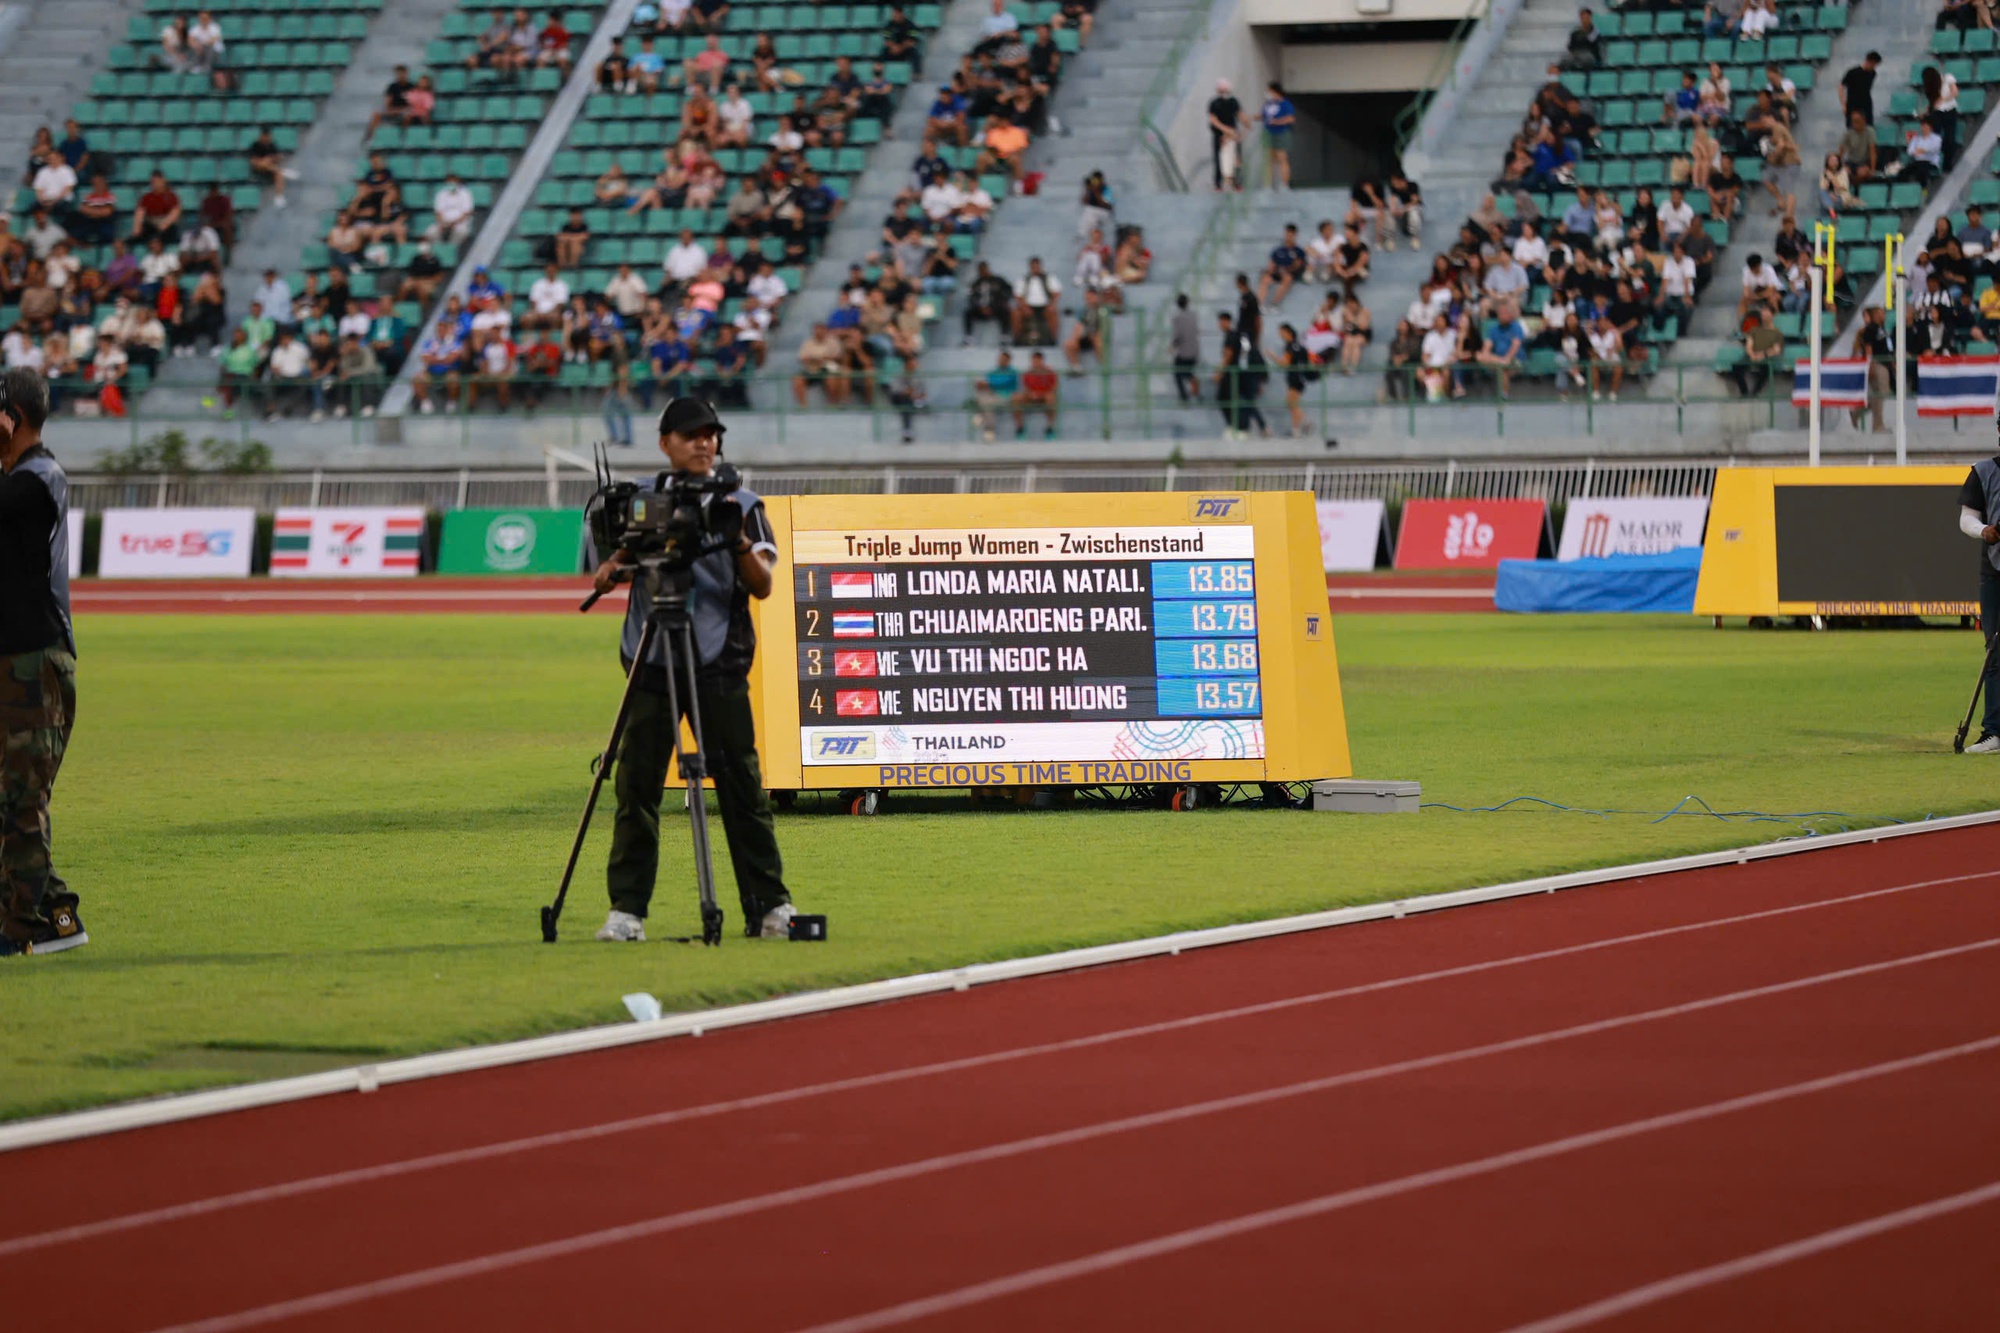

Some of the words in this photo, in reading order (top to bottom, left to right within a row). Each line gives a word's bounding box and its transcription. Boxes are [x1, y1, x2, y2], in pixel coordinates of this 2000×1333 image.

[1619, 520, 1682, 539] MAJOR
[844, 535, 901, 561] Triple
[908, 535, 962, 560] Jump
[968, 534, 1039, 555] Women
[1060, 532, 1204, 554] Zwischenstand
[807, 570, 814, 598] 1
[873, 572, 898, 598] INA
[907, 570, 981, 595] LONDA
[988, 569, 1057, 594] MARIA
[1063, 568, 1145, 593] NATALI.
[1188, 565, 1253, 592] 13.85
[806, 609, 820, 636] 2
[876, 612, 904, 637] THA
[910, 607, 1083, 634] CHUAIMAROENG
[1090, 607, 1147, 632] PARI.
[1192, 604, 1254, 631] 13.79
[1816, 601, 1881, 615] PRECIOUS
[1886, 601, 1915, 615] TIME
[1919, 601, 1976, 615] TRADING
[807, 649, 822, 676] 3
[877, 651, 901, 676] VIE
[910, 649, 941, 673] VU
[947, 648, 982, 673] THI
[990, 648, 1050, 672] NGOC
[1057, 647, 1088, 671] HA
[1192, 643, 1257, 670] 13.68
[809, 688, 823, 715] 4
[878, 690, 902, 715] VIE
[912, 687, 1002, 713] NGUYEN
[1008, 686, 1044, 711] THI
[1051, 685, 1127, 710] HUONG
[1196, 682, 1258, 709] 13.57
[912, 735, 1006, 750] THAILAND
[879, 765, 1006, 785] PRECIOUS
[1013, 763, 1072, 783] TIME
[1079, 762, 1192, 782] TRADING
